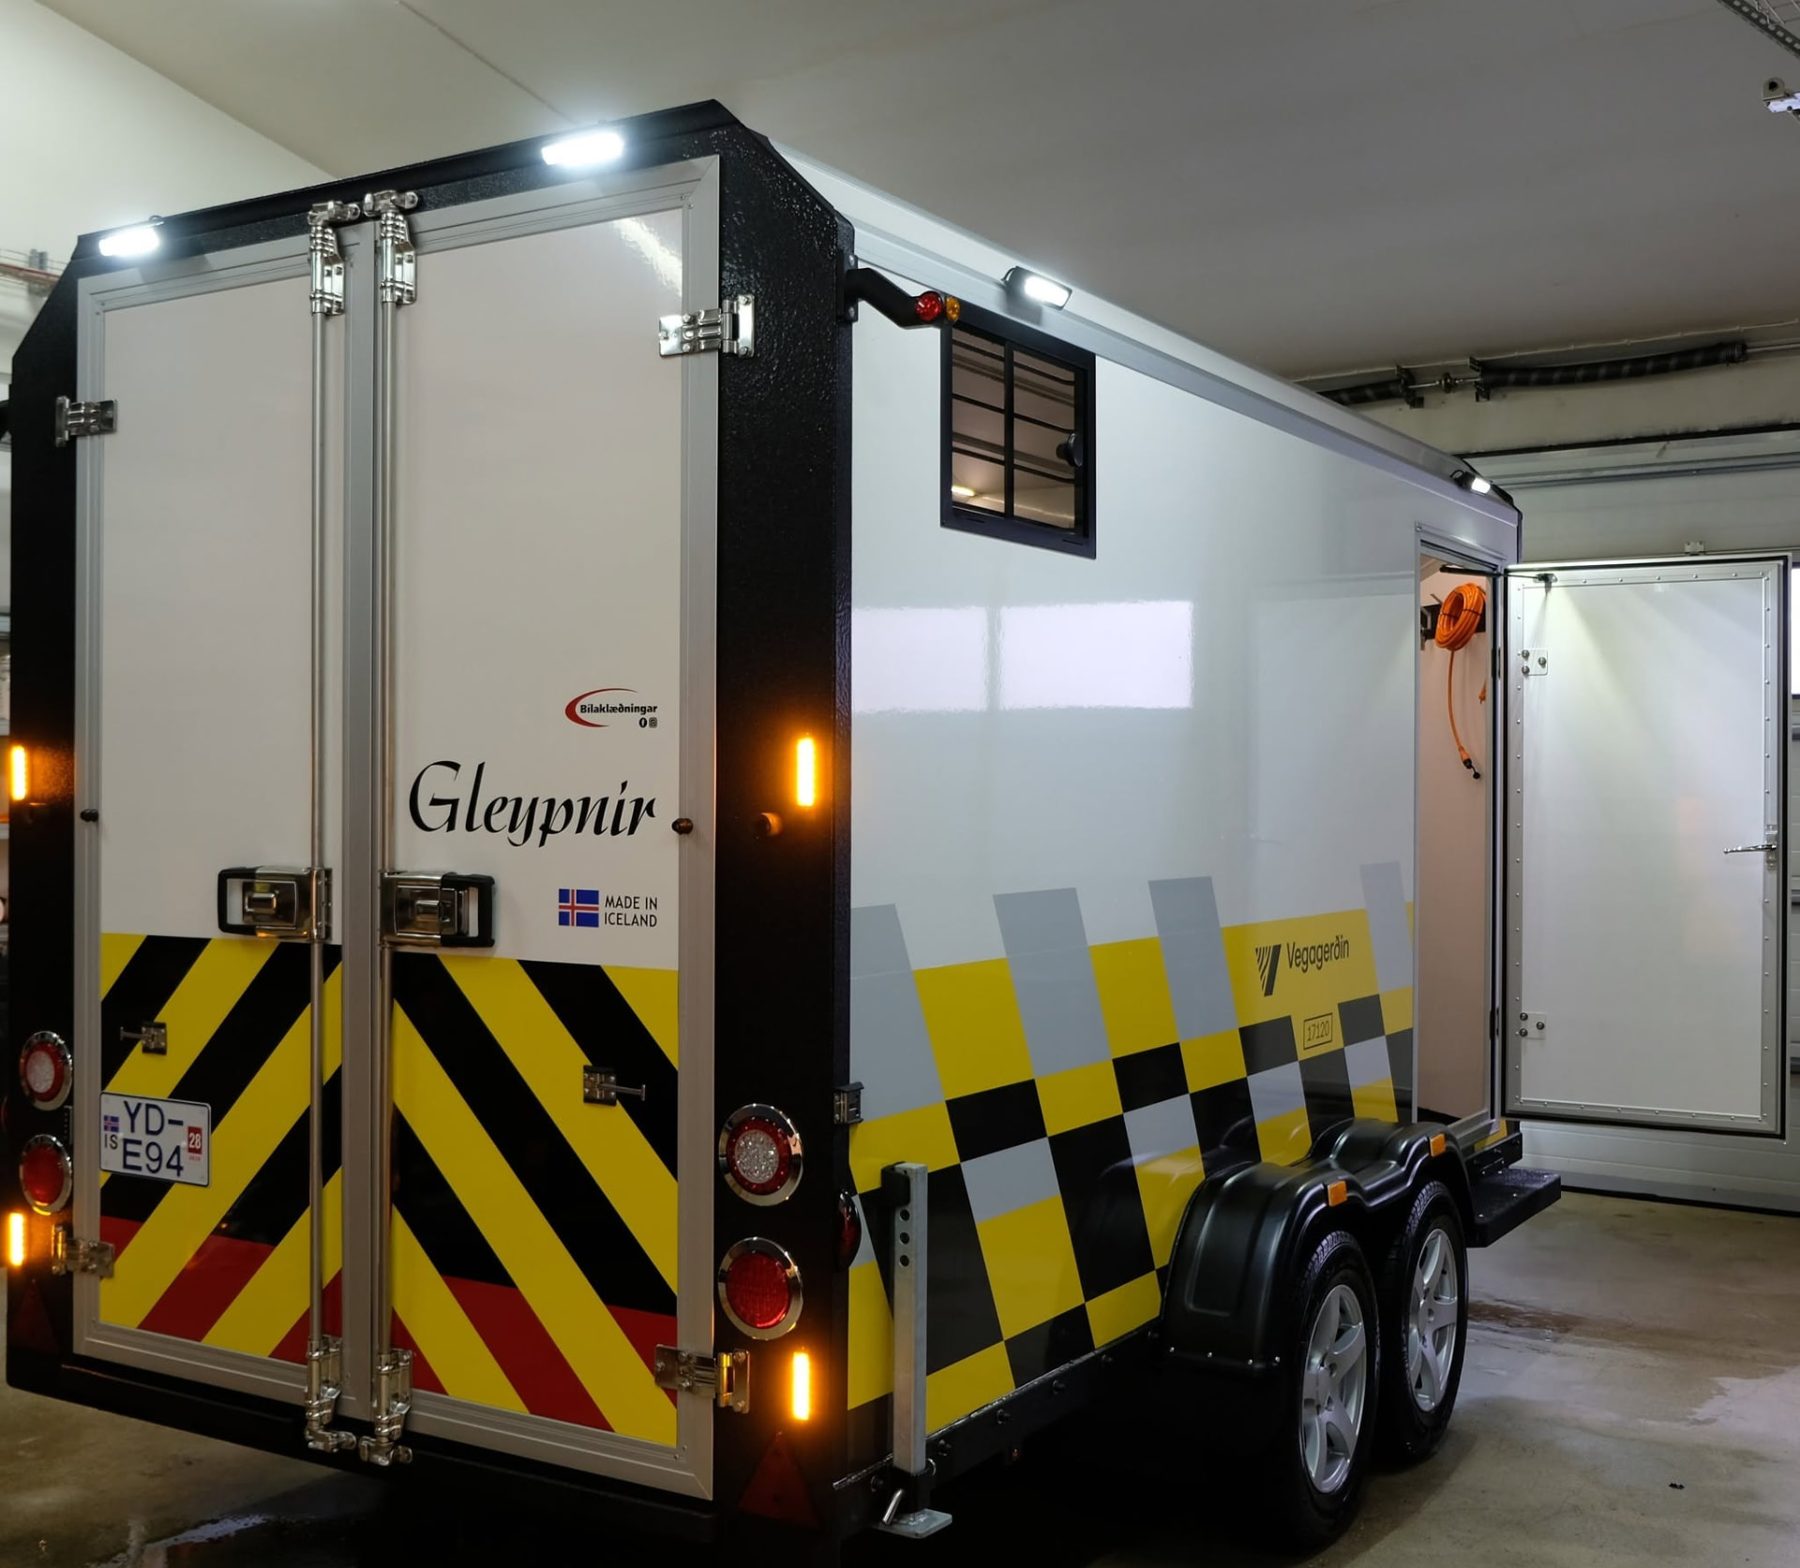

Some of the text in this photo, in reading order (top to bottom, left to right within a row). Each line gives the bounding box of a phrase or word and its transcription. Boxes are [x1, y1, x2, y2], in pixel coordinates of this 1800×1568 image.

[580, 703, 658, 715] Bilaklæðningar
[408, 760, 657, 848] Gleypnir
[605, 895, 658, 911] MADE IN
[604, 911, 658, 928] ICELAND
[1286, 934, 1350, 974] Vegagerðin
[1307, 1020, 1330, 1042] 17120
[104, 1134, 119, 1150] IS
[189, 1132, 202, 1149] 28
[122, 1138, 184, 1178] E94
